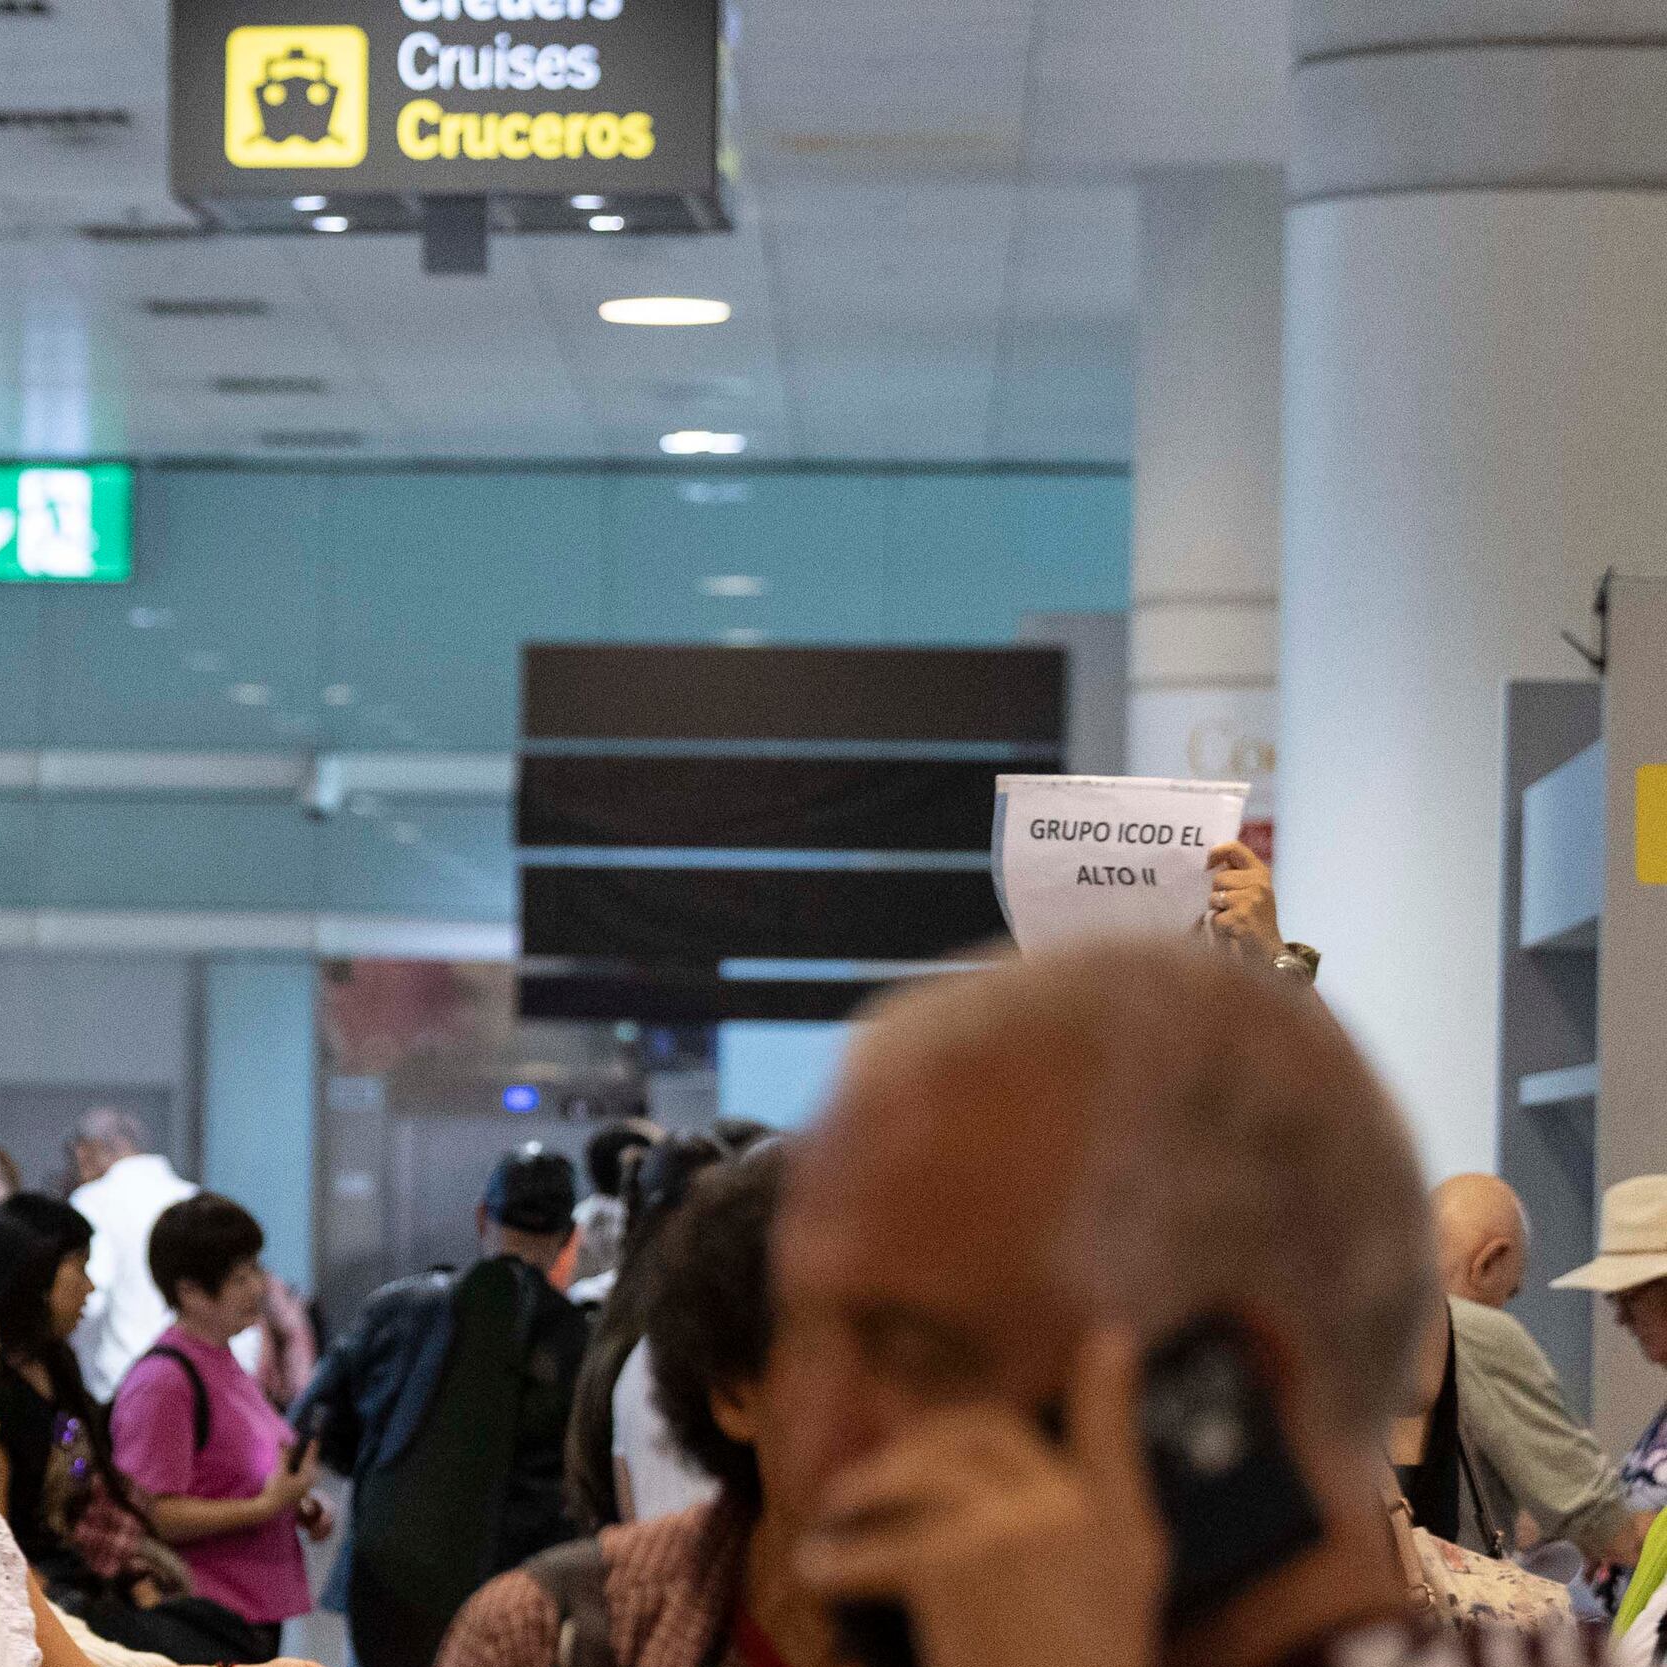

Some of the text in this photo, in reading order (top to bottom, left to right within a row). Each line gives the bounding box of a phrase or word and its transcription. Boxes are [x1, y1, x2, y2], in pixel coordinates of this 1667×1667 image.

[397, 31, 601, 91] Cruises
[396, 99, 656, 161] Cruceros
[1029, 818, 1205, 847] GRUPO ICOD EL
[1076, 864, 1157, 887] ALTO II
